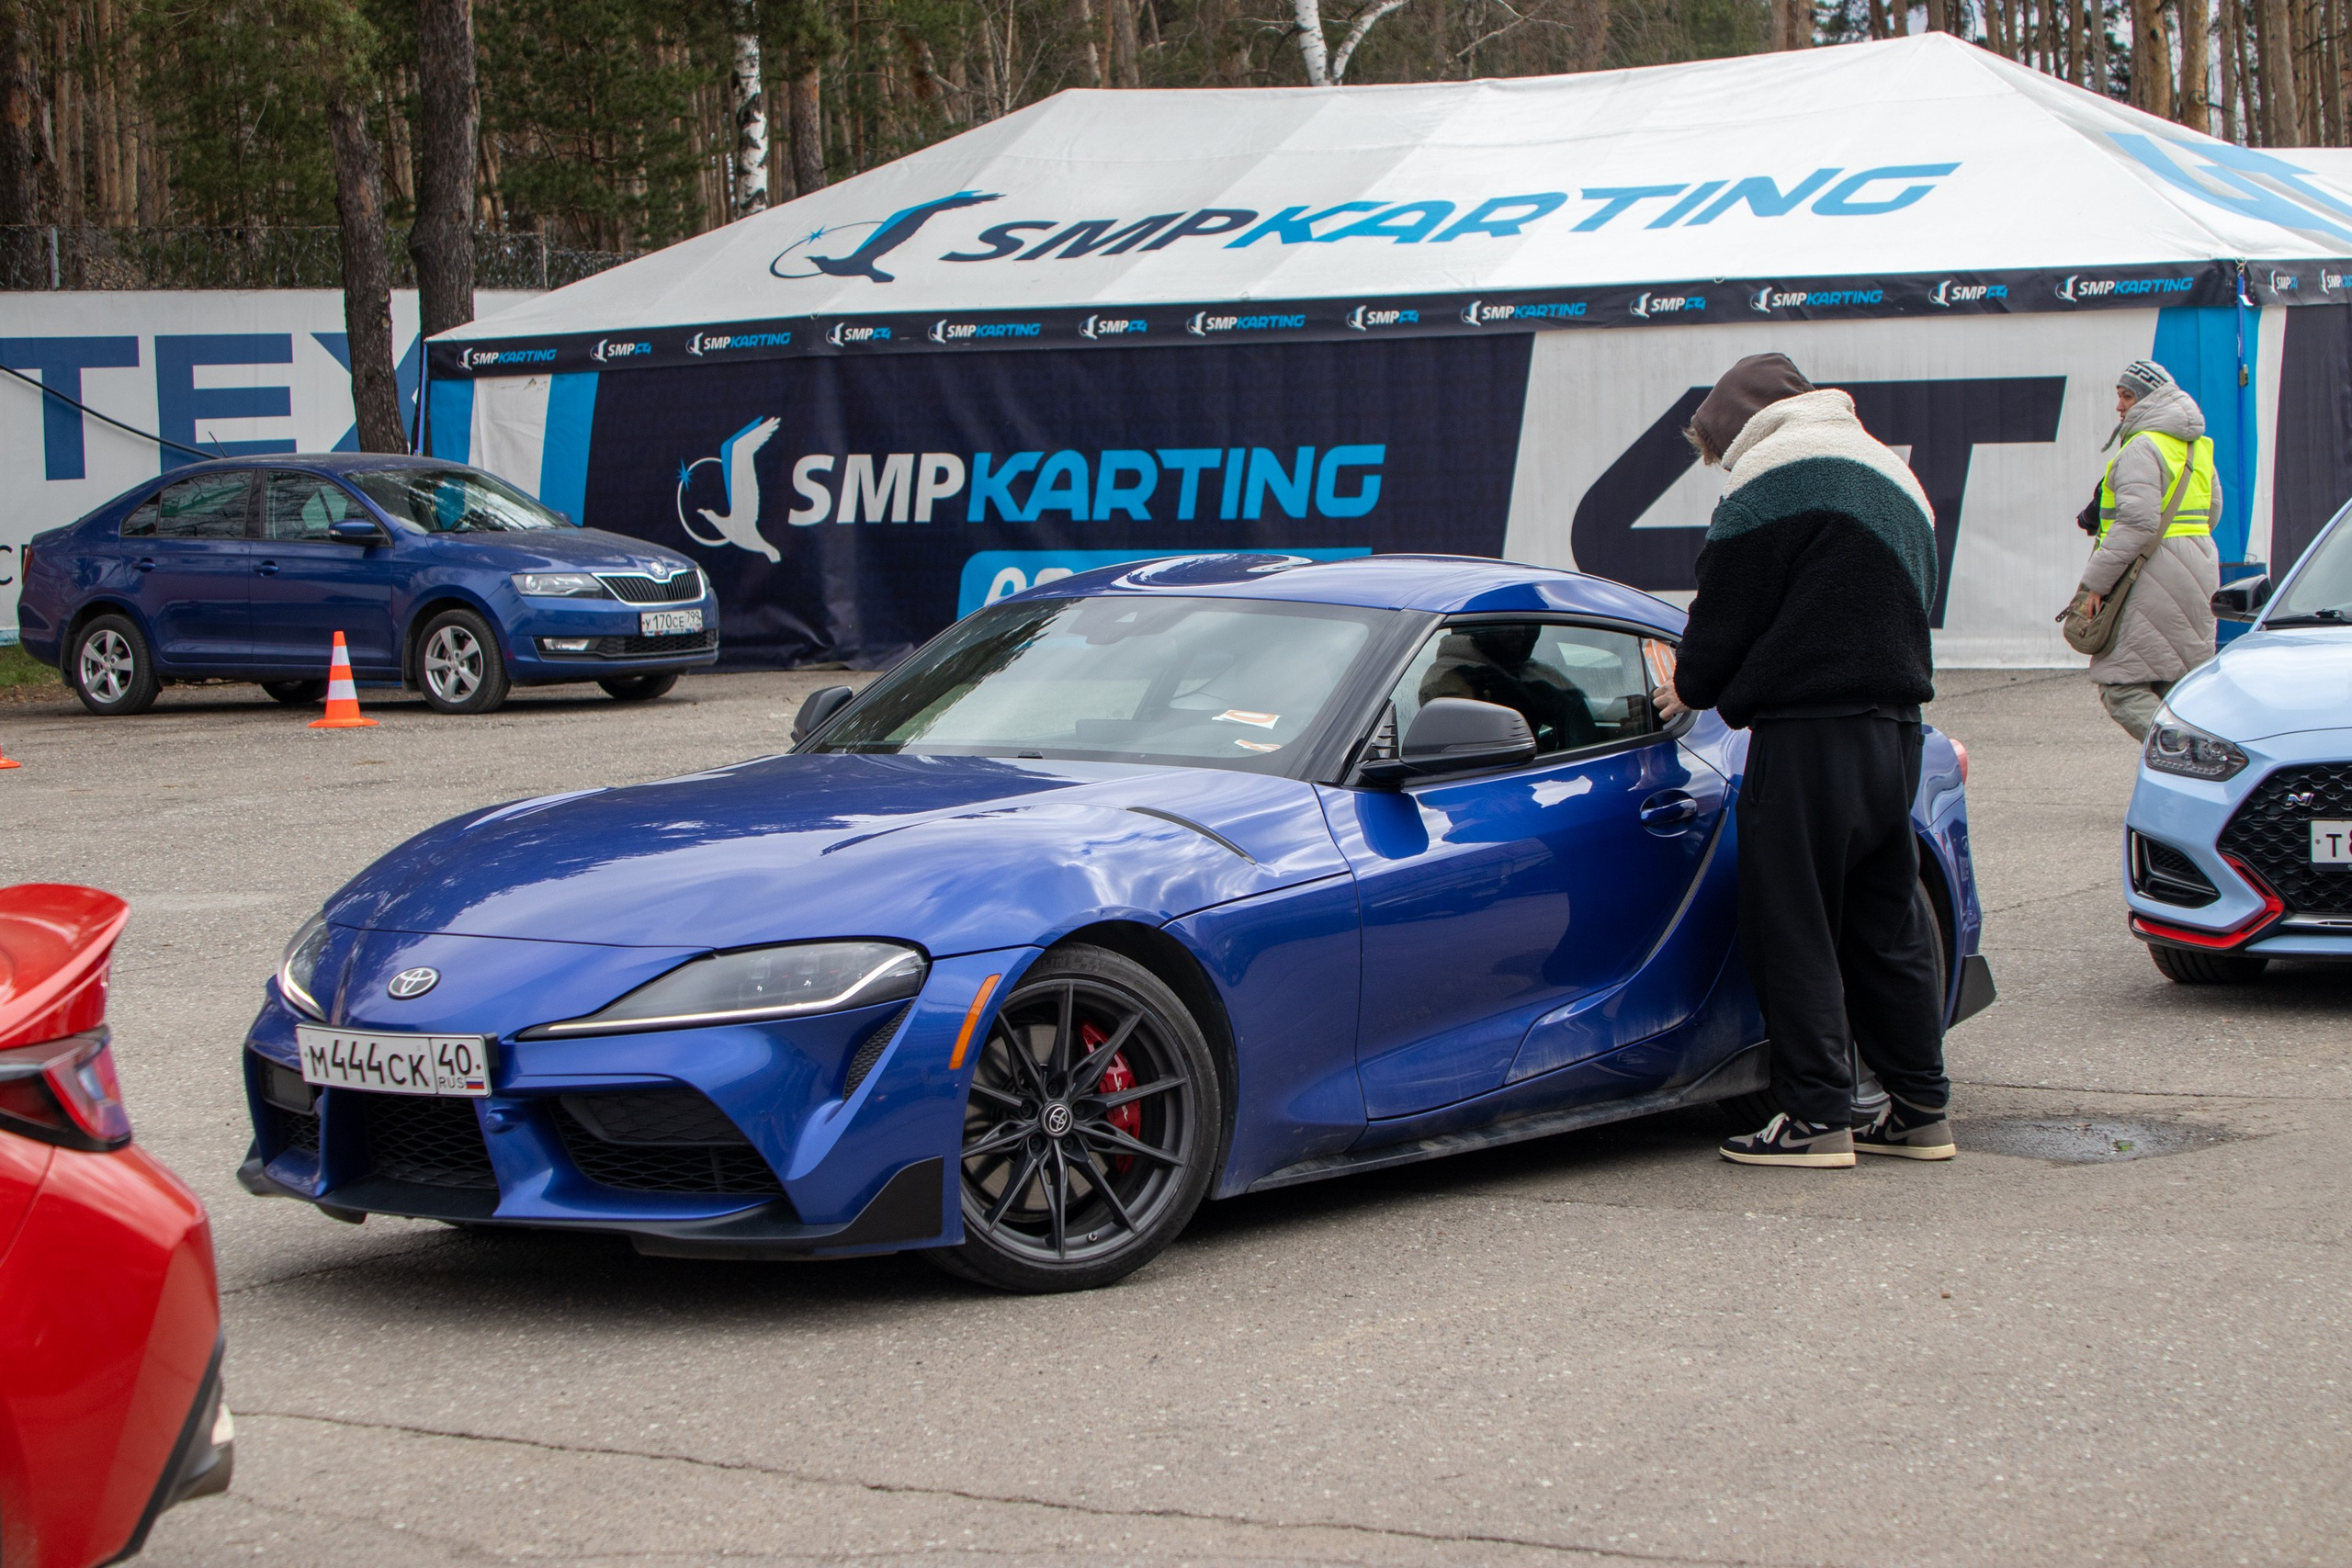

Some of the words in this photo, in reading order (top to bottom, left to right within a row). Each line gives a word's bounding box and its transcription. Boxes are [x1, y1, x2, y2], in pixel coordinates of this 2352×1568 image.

[2325, 829, 2352, 858] Т
[438, 1043, 472, 1076] 40
[438, 1077, 465, 1089] RUS
